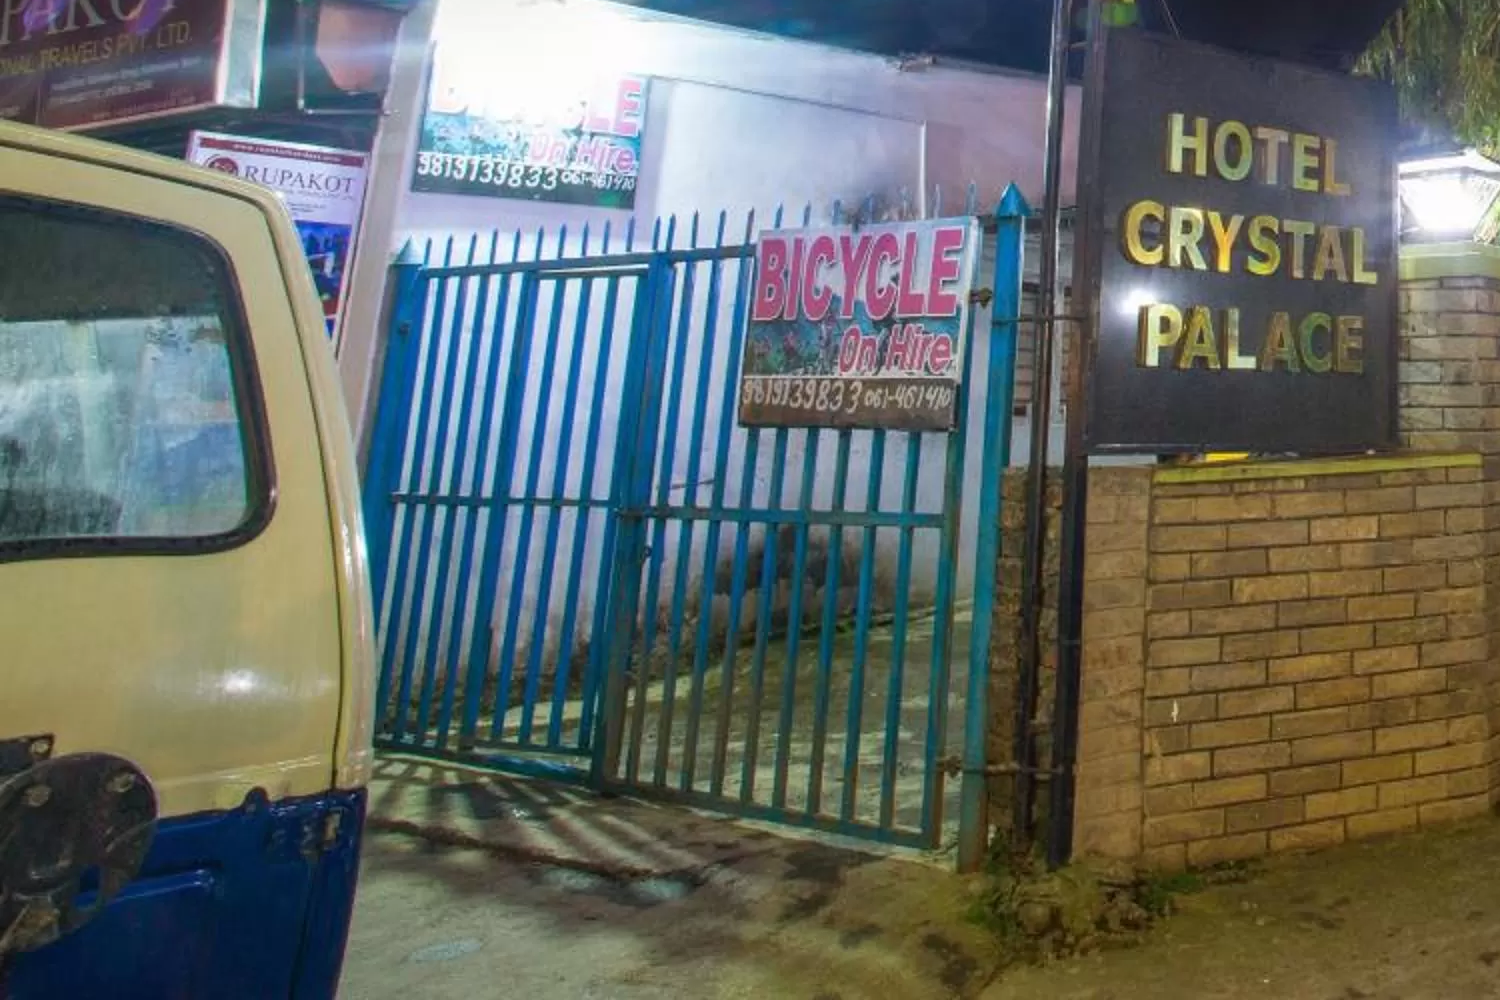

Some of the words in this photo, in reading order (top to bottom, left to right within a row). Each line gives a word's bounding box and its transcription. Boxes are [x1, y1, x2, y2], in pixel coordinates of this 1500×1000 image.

[40, 36, 113, 70] TRAVELS
[244, 164, 357, 194] RUPAKOT
[1166, 112, 1351, 196] HOTEL
[752, 226, 964, 321] BICYCLE
[1124, 199, 1378, 285] CRYSTAL
[838, 324, 878, 375] On
[884, 323, 953, 376] Hire
[1137, 302, 1366, 374] PALACE
